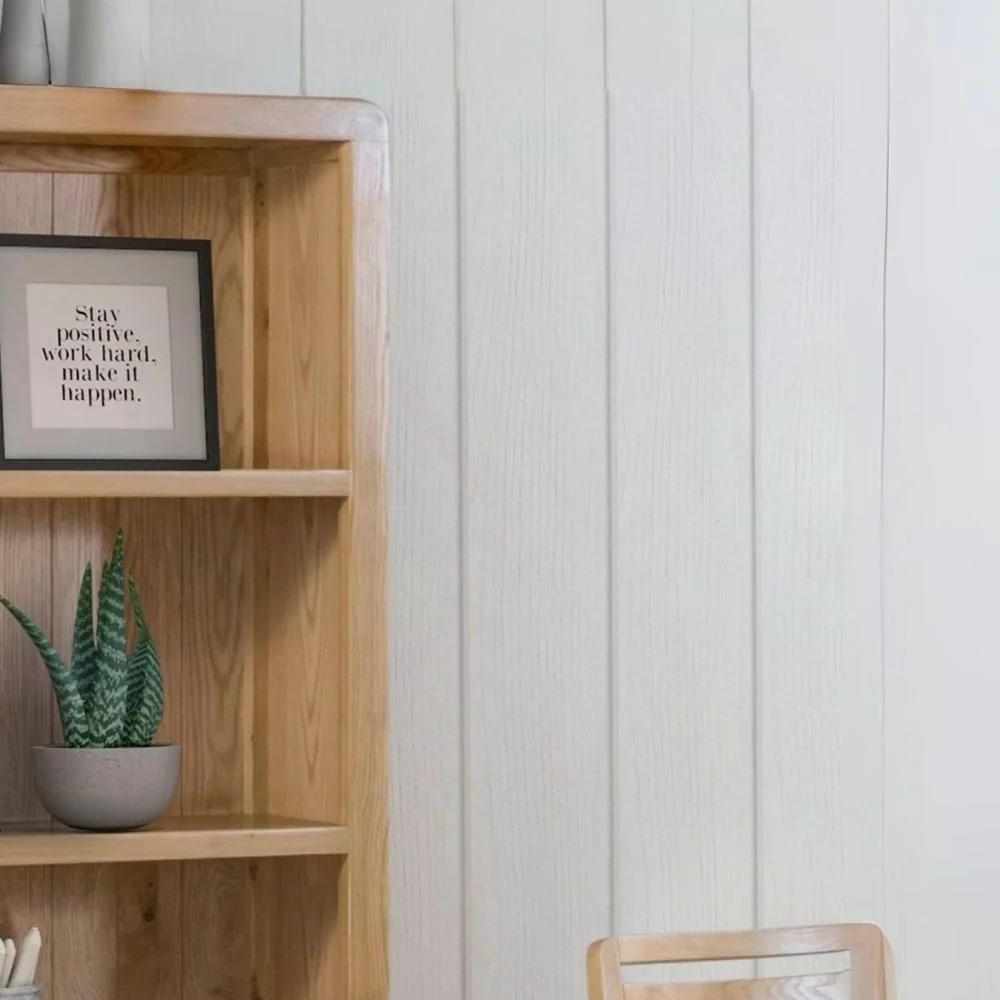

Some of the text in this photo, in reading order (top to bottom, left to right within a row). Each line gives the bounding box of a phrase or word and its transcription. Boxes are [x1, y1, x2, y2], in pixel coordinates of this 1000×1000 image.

[75, 304, 120, 325] Stay
[57, 323, 140, 346] positive.
[42, 345, 92, 361] work
[62, 363, 140, 382] make it
[62, 384, 141, 407] happen.
